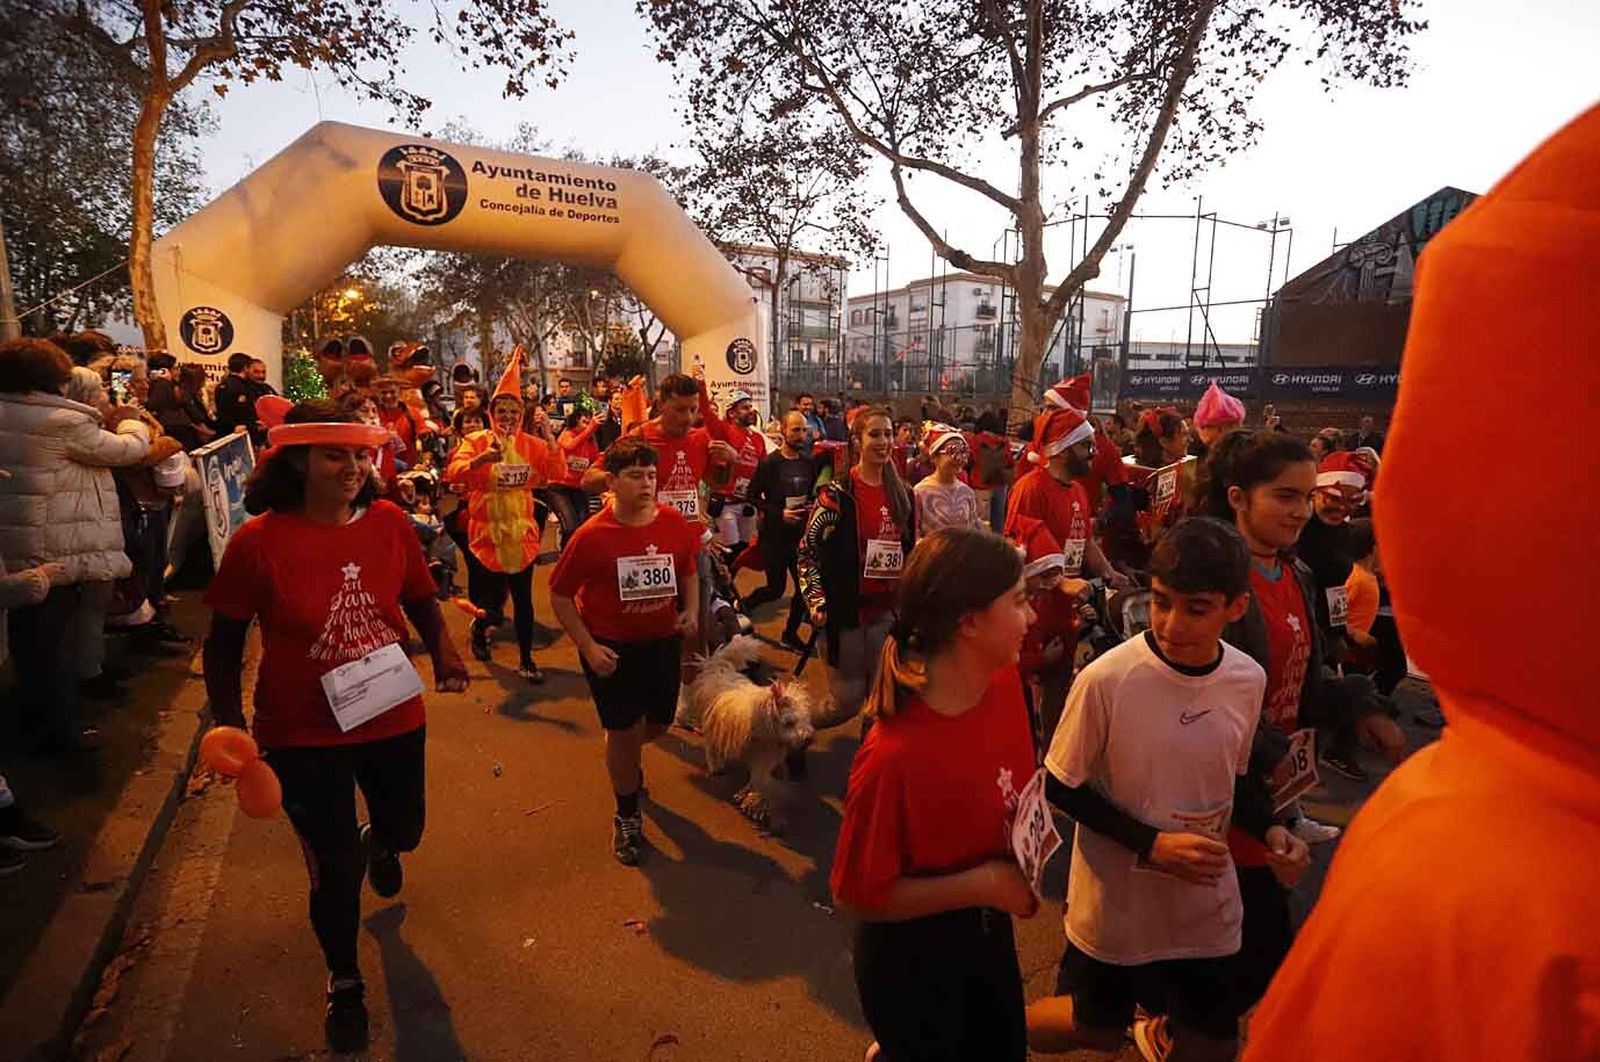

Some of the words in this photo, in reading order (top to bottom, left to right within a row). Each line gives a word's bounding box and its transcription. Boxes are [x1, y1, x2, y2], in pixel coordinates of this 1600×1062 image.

[471, 160, 617, 192] Ayuntamiento
[516, 184, 542, 200] de
[548, 186, 618, 209] Huelva
[549, 207, 565, 218] de
[567, 209, 620, 224] Deportes
[1144, 376, 1181, 384] HYUNDAI
[1291, 375, 1342, 385] HYUNDAI
[677, 500, 696, 513] 379
[643, 567, 671, 586] 380
